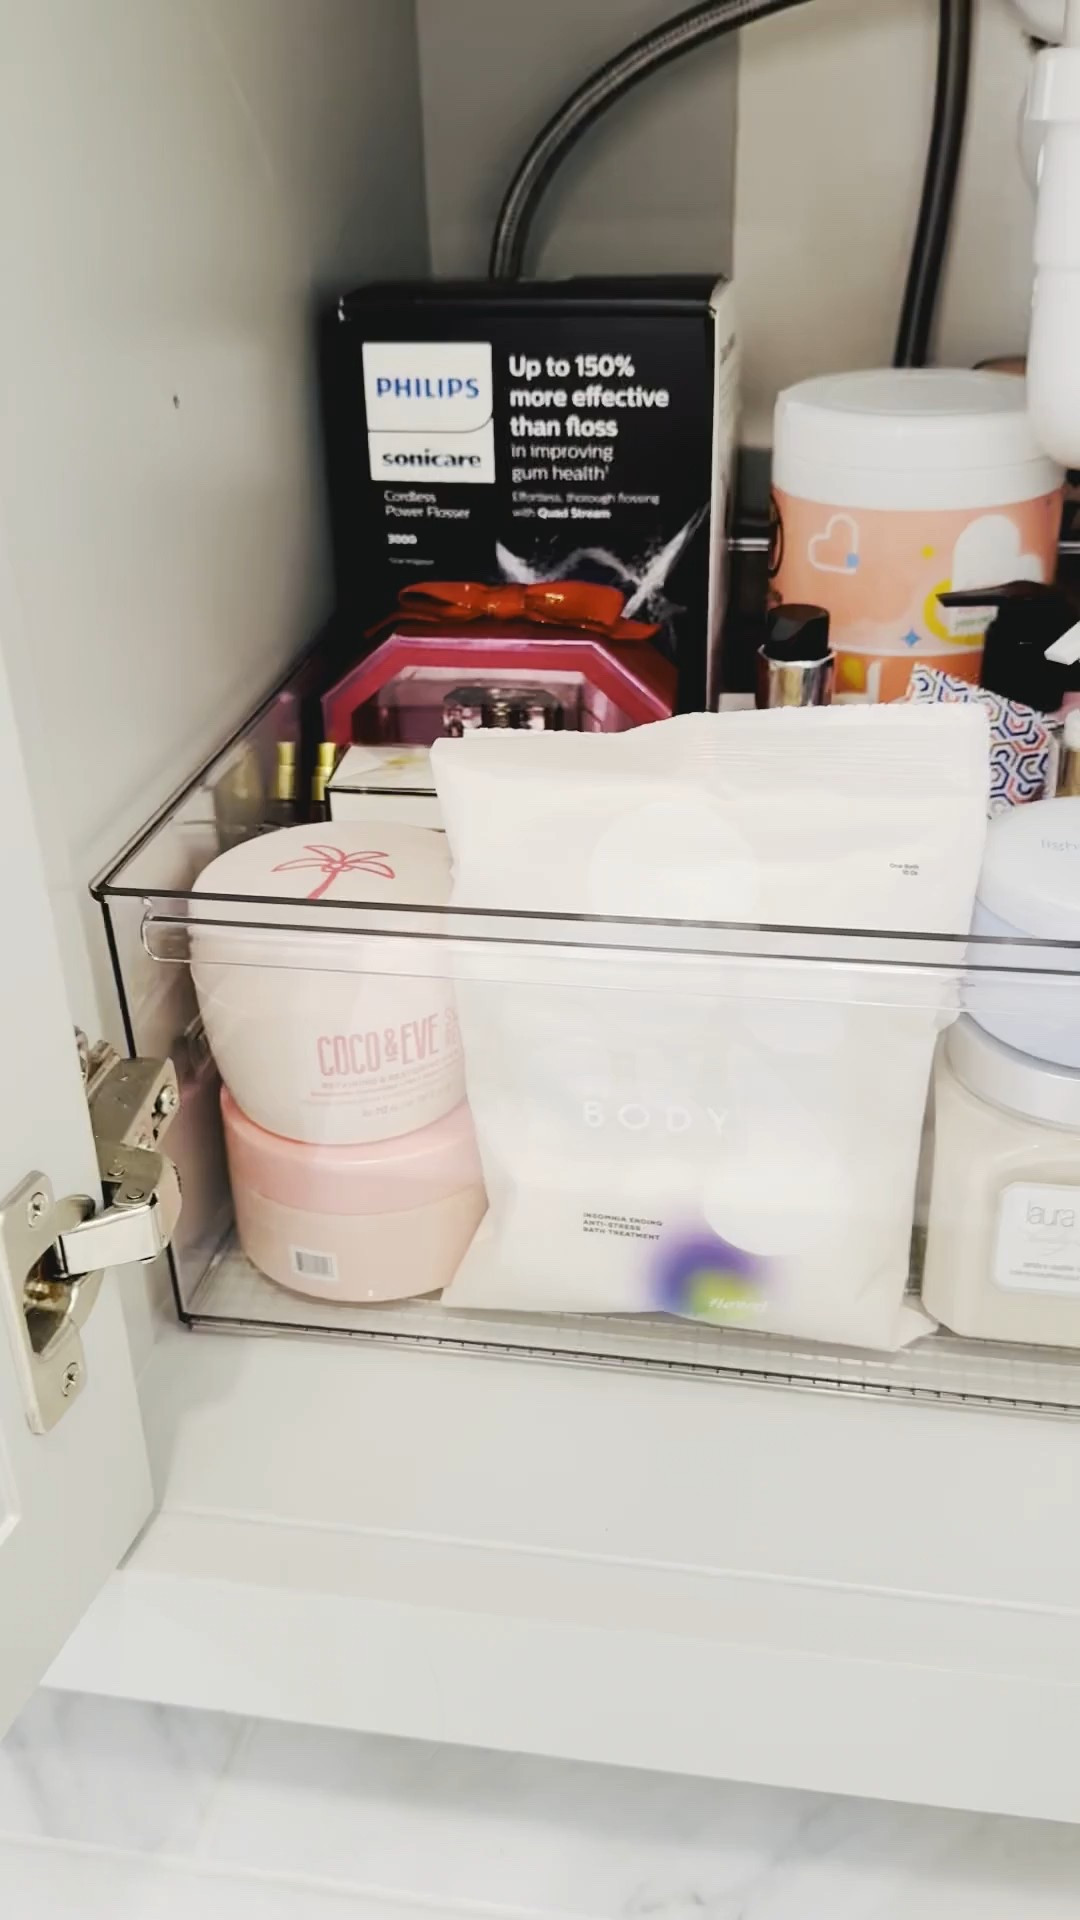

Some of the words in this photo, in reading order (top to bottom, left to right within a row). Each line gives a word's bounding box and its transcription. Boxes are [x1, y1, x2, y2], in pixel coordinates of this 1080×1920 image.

[508, 354, 541, 381] Up
[546, 355, 570, 377] to
[574, 354, 635, 377] 150%
[376, 377, 480, 399] PHILIPS
[509, 389, 568, 408] more
[571, 384, 669, 408] effective
[510, 414, 561, 437] than
[566, 413, 618, 437] floss
[381, 448, 482, 468] sonicare
[511, 444, 526, 458] in
[530, 444, 614, 462] improving
[511, 467, 548, 483] gum
[385, 505, 424, 517] Power
[427, 505, 470, 519] Flosser
[537, 507, 569, 519] Quad
[570, 507, 611, 519] Stream
[584, 1102, 729, 1136] BODY
[583, 1212, 627, 1222] INSOMNIA
[1026, 1200, 1075, 1227] laura
[608, 1229, 660, 1240] TREATMENT
